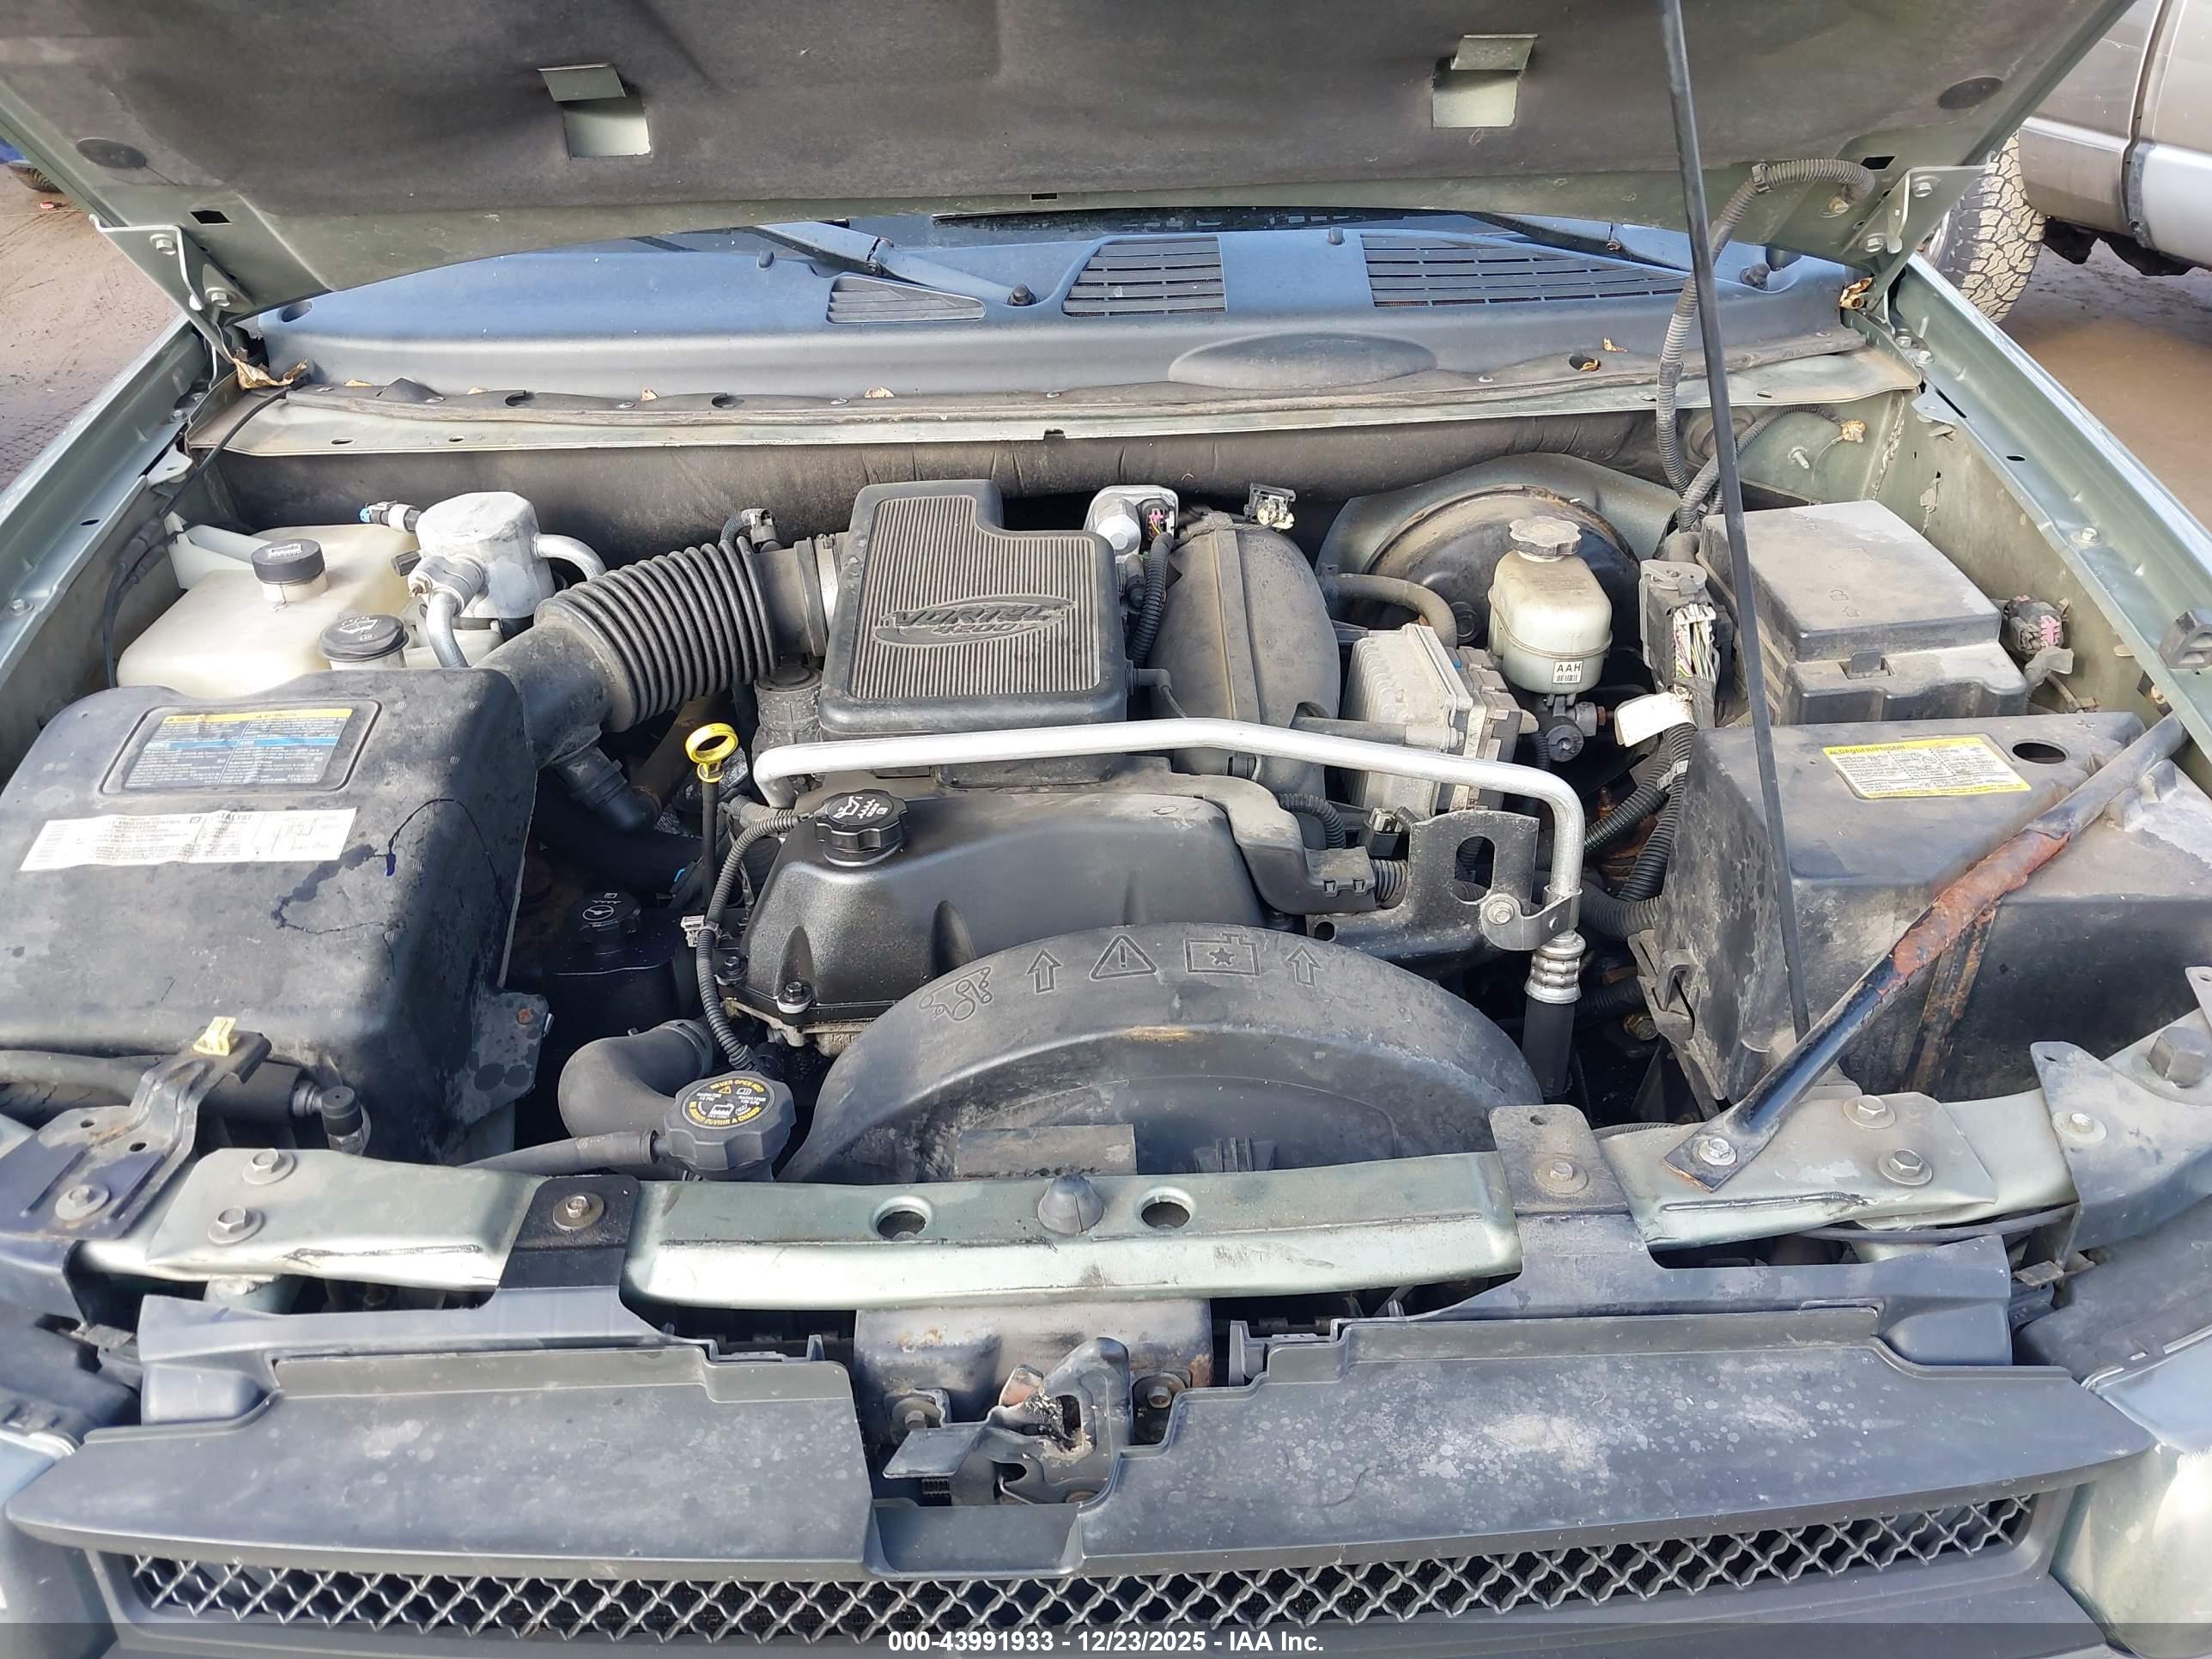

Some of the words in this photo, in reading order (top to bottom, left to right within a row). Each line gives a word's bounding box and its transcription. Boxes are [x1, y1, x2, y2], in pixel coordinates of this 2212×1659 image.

[933, 623, 1018, 635] 4200
[1557, 663, 1581, 673] AAH
[709, 1079, 733, 1090] NEVER
